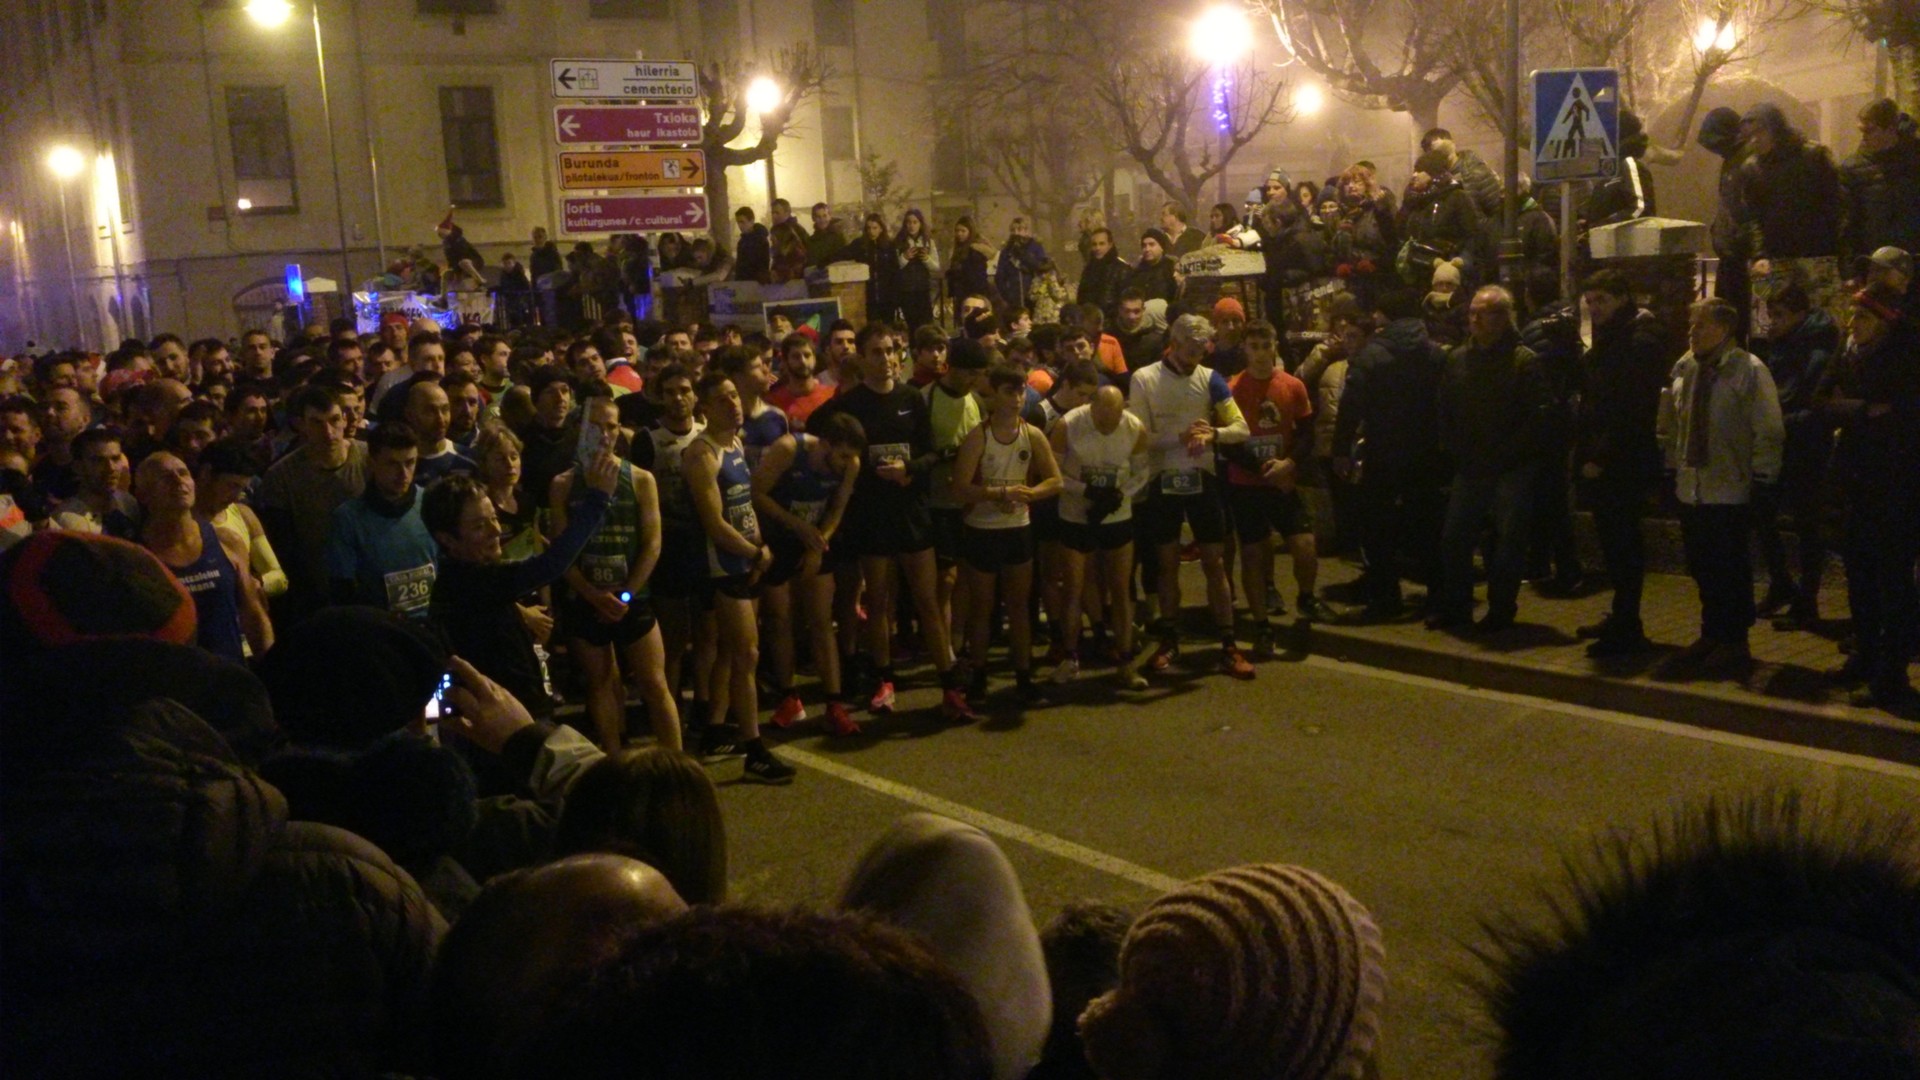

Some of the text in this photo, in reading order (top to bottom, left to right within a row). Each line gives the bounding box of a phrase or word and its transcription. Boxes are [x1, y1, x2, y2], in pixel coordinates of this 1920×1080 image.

[635, 65, 680, 77] hilerria
[623, 83, 694, 95] cementerio
[654, 112, 697, 124] Txioka
[627, 128, 651, 138] haur
[563, 158, 620, 169] Burunda
[566, 203, 602, 214] Iortia
[645, 215, 683, 225] cultural
[1090, 475, 1108, 488] 20
[1172, 475, 1192, 488] 62
[593, 567, 614, 582] 86
[397, 579, 429, 601] 236
